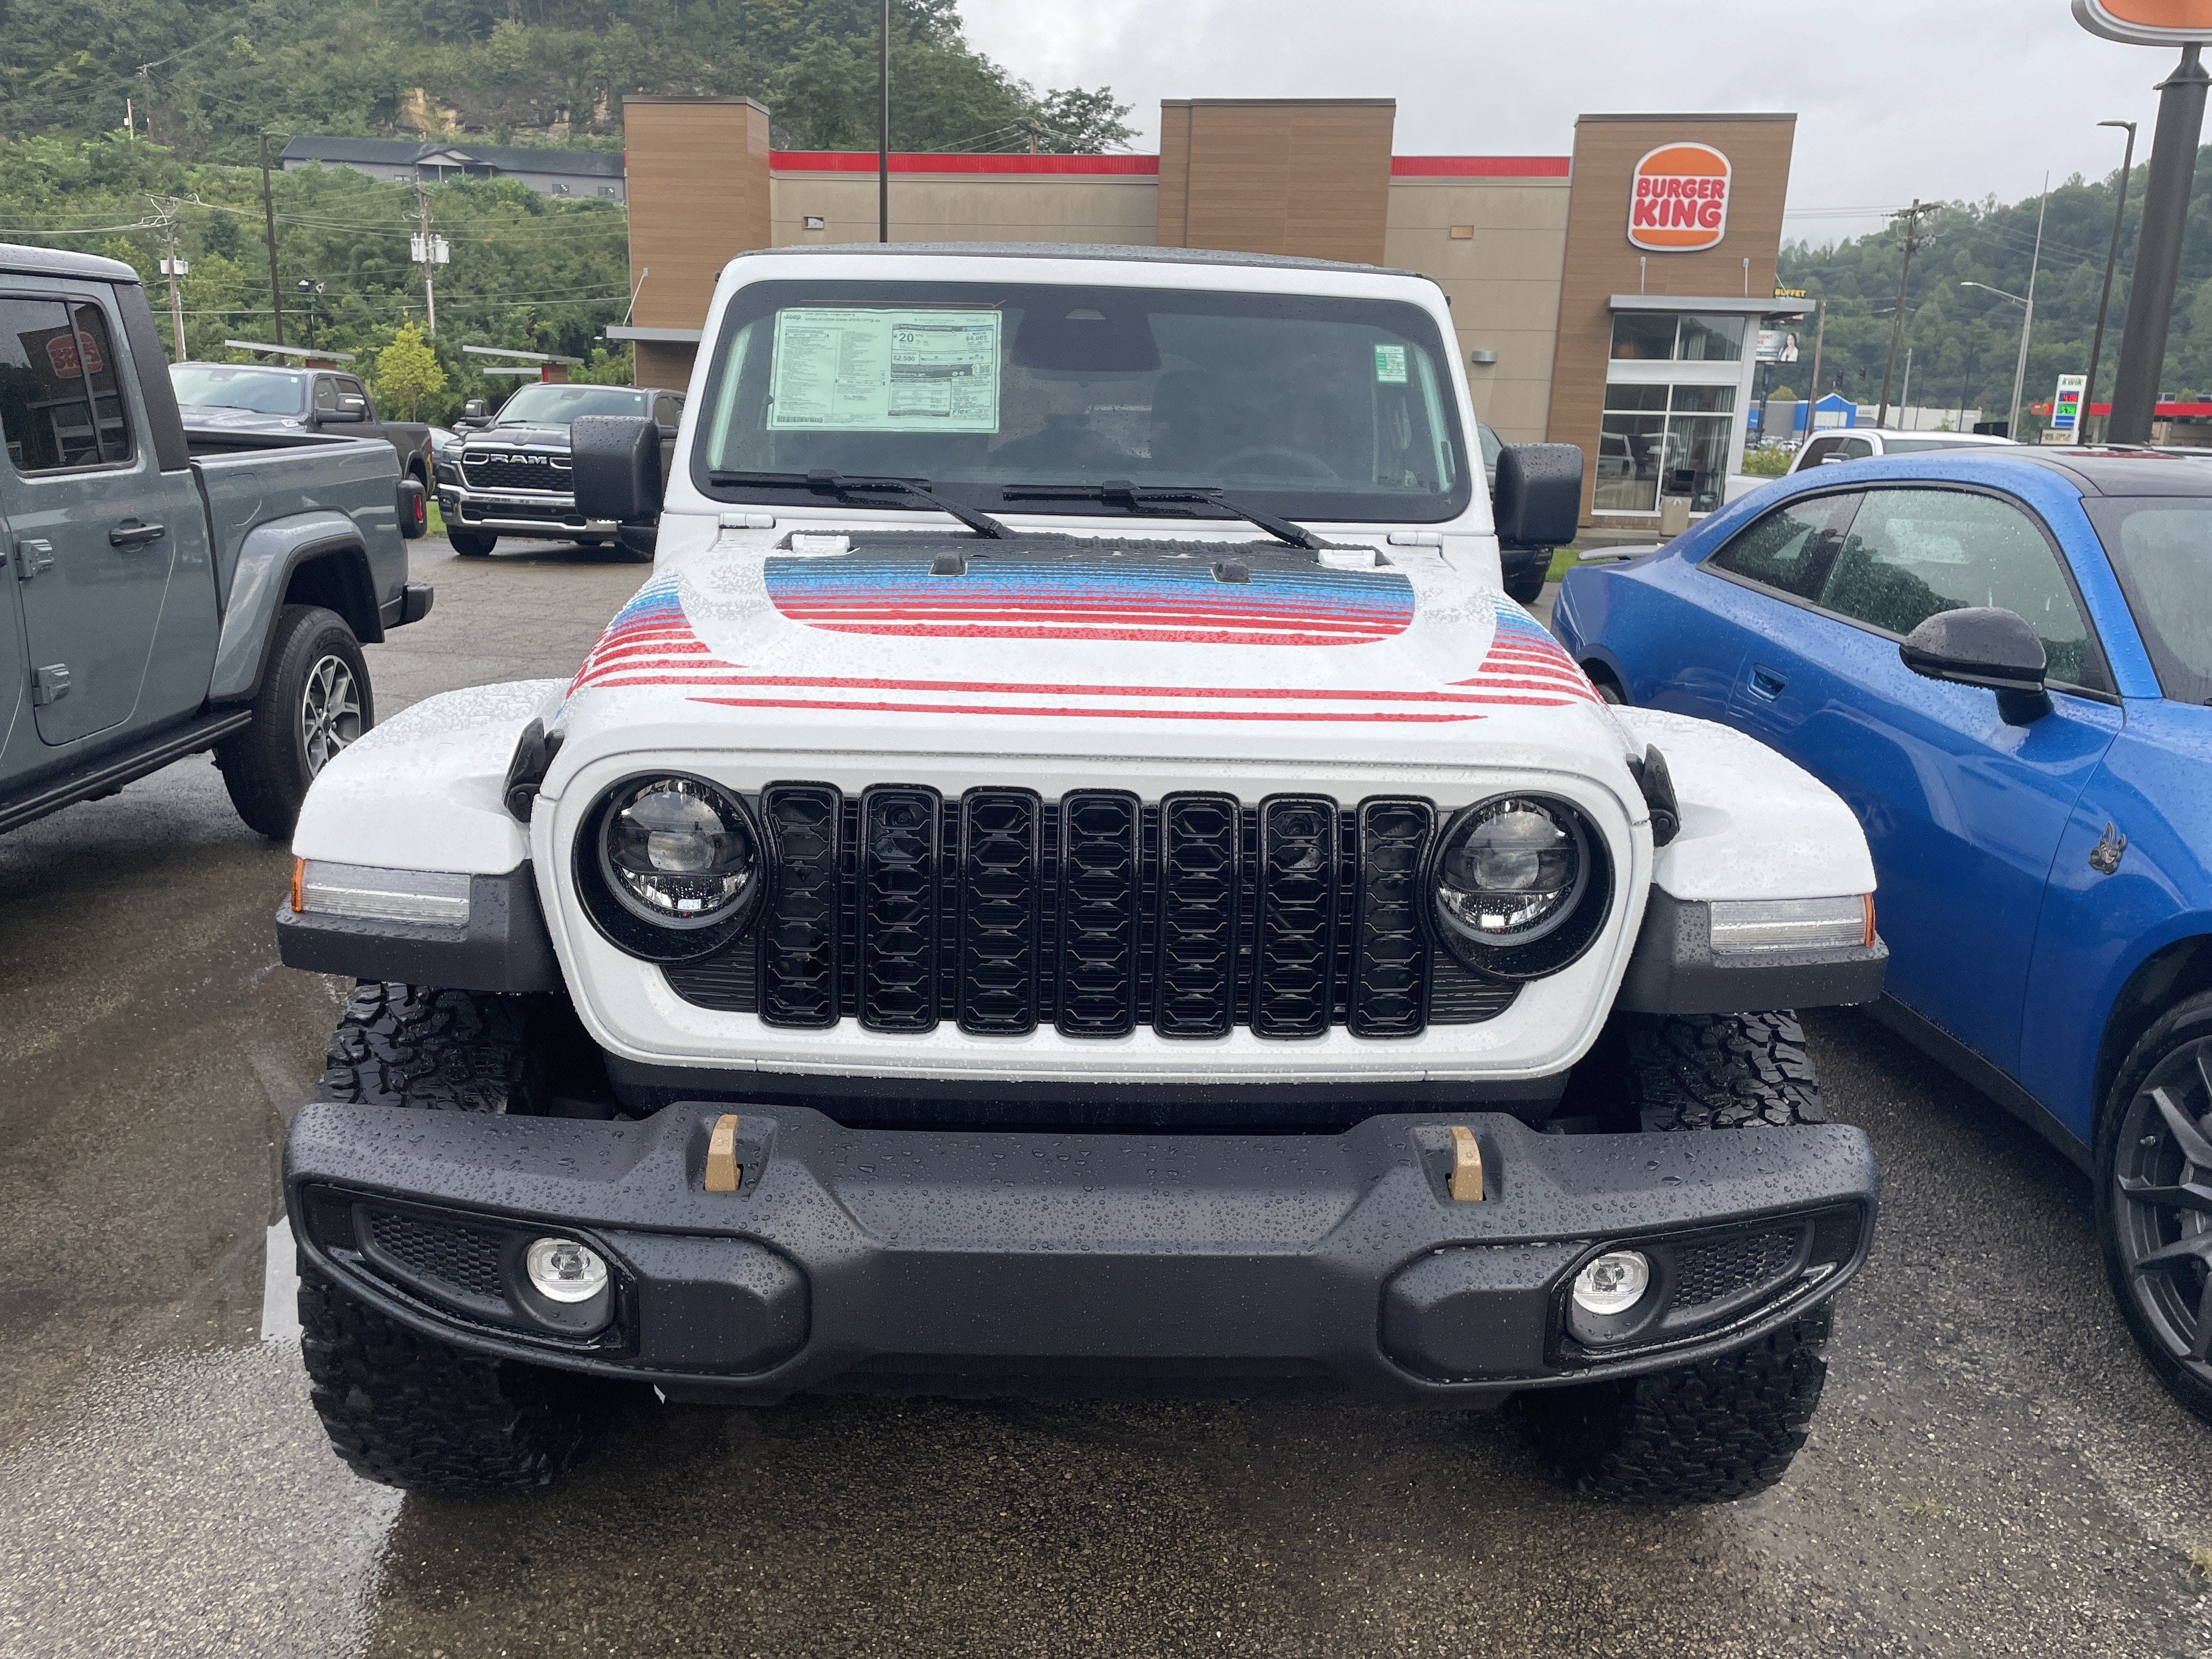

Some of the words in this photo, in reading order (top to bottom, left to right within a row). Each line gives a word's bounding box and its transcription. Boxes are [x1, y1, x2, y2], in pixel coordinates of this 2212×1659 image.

[1637, 178, 1725, 199] BURGER
[1633, 198, 1722, 228] KING
[1775, 288, 1807, 297] BUFFET
[899, 332, 914, 342] 20
[490, 453, 547, 465] RAM
